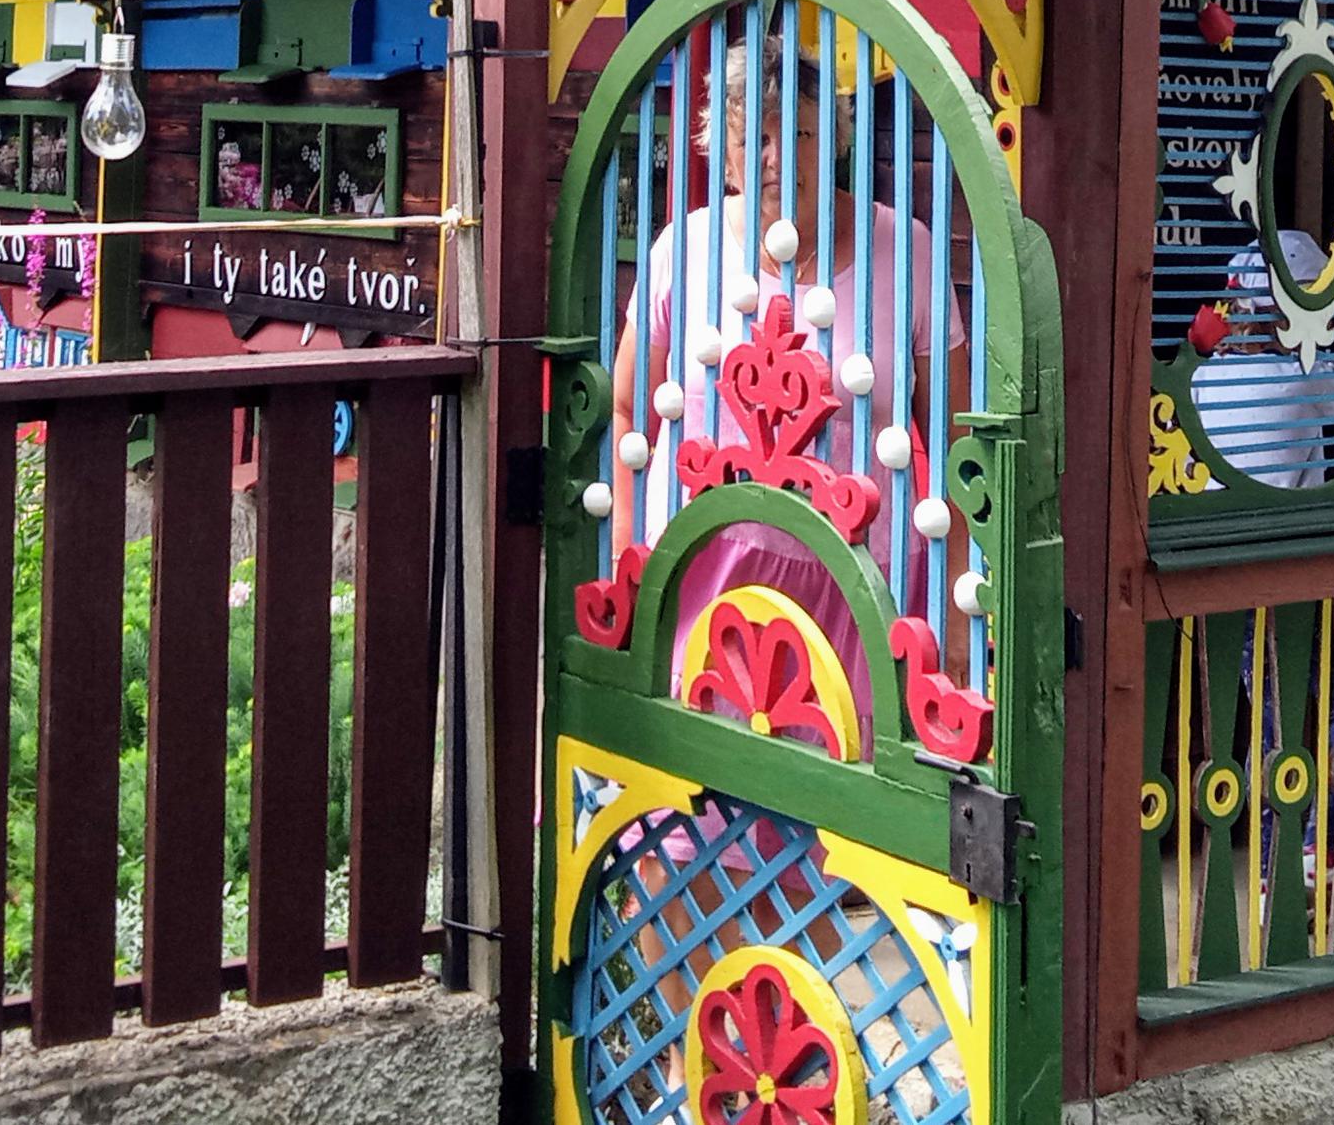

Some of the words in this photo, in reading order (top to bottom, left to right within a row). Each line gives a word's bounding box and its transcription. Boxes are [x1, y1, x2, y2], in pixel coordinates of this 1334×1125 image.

[183, 239, 193, 286] i
[213, 242, 242, 305] ty
[259, 247, 328, 302] také
[346, 256, 427, 315] tvoř.
